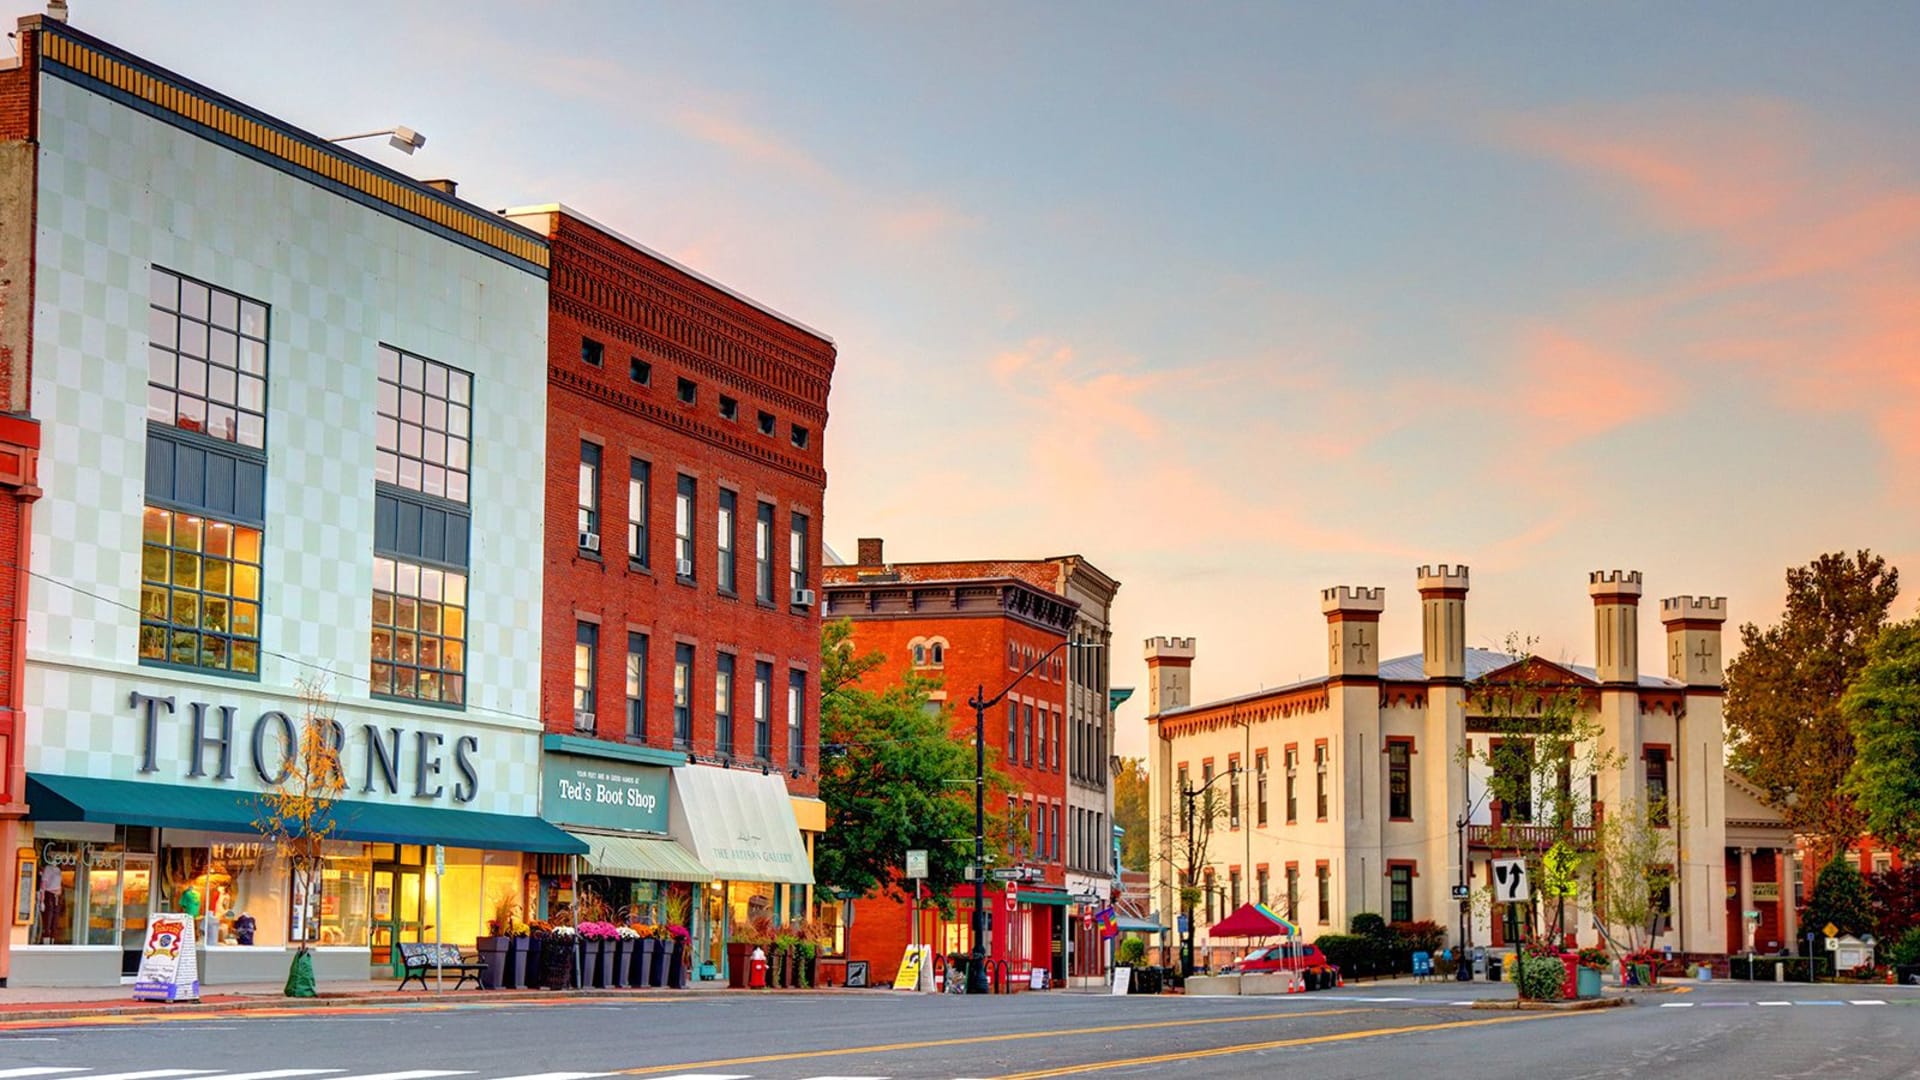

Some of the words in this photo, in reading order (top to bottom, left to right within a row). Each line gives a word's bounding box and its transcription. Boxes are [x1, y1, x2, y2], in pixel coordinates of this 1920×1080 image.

[130, 691, 479, 803] THORNES
[559, 779, 592, 802] Ted's
[596, 783, 623, 805] Boot
[627, 787, 656, 814] Shop
